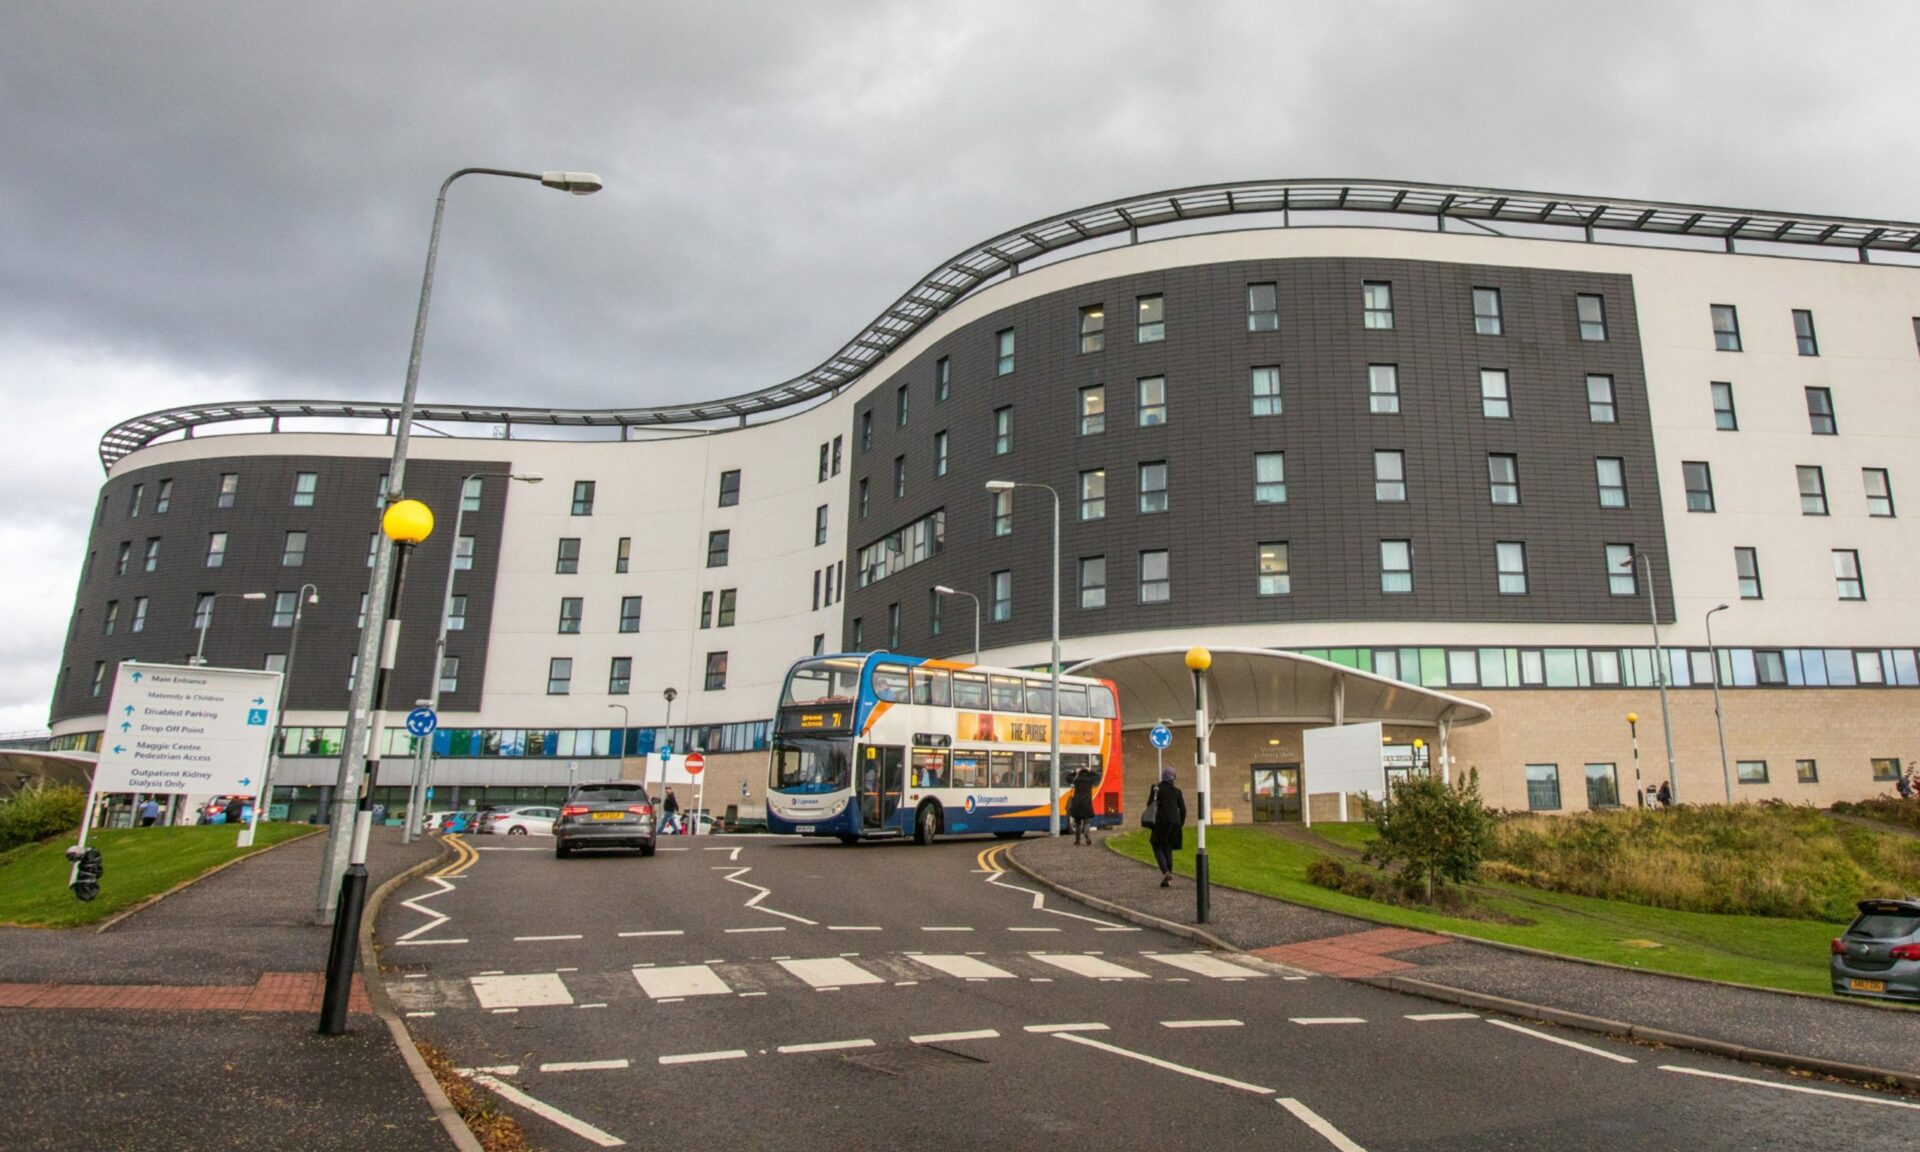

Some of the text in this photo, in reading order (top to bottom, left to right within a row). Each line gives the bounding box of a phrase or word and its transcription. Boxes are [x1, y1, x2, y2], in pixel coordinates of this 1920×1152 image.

[151, 675, 207, 685] Main Entrance
[148, 692, 183, 701] Maternity
[144, 708, 218, 720] Disabled Parking
[141, 724, 163, 733] Drop
[181, 726, 204, 734] Point
[1010, 722, 1024, 742] THE
[1025, 723, 1047, 743] PURGE
[137, 742, 201, 751] Maggie Centre
[134, 751, 211, 762] Pedestrian Access
[131, 768, 212, 780] Outpatient Kidney
[129, 779, 186, 789] Dialysis Only
[977, 794, 1008, 805] Stagecoach
